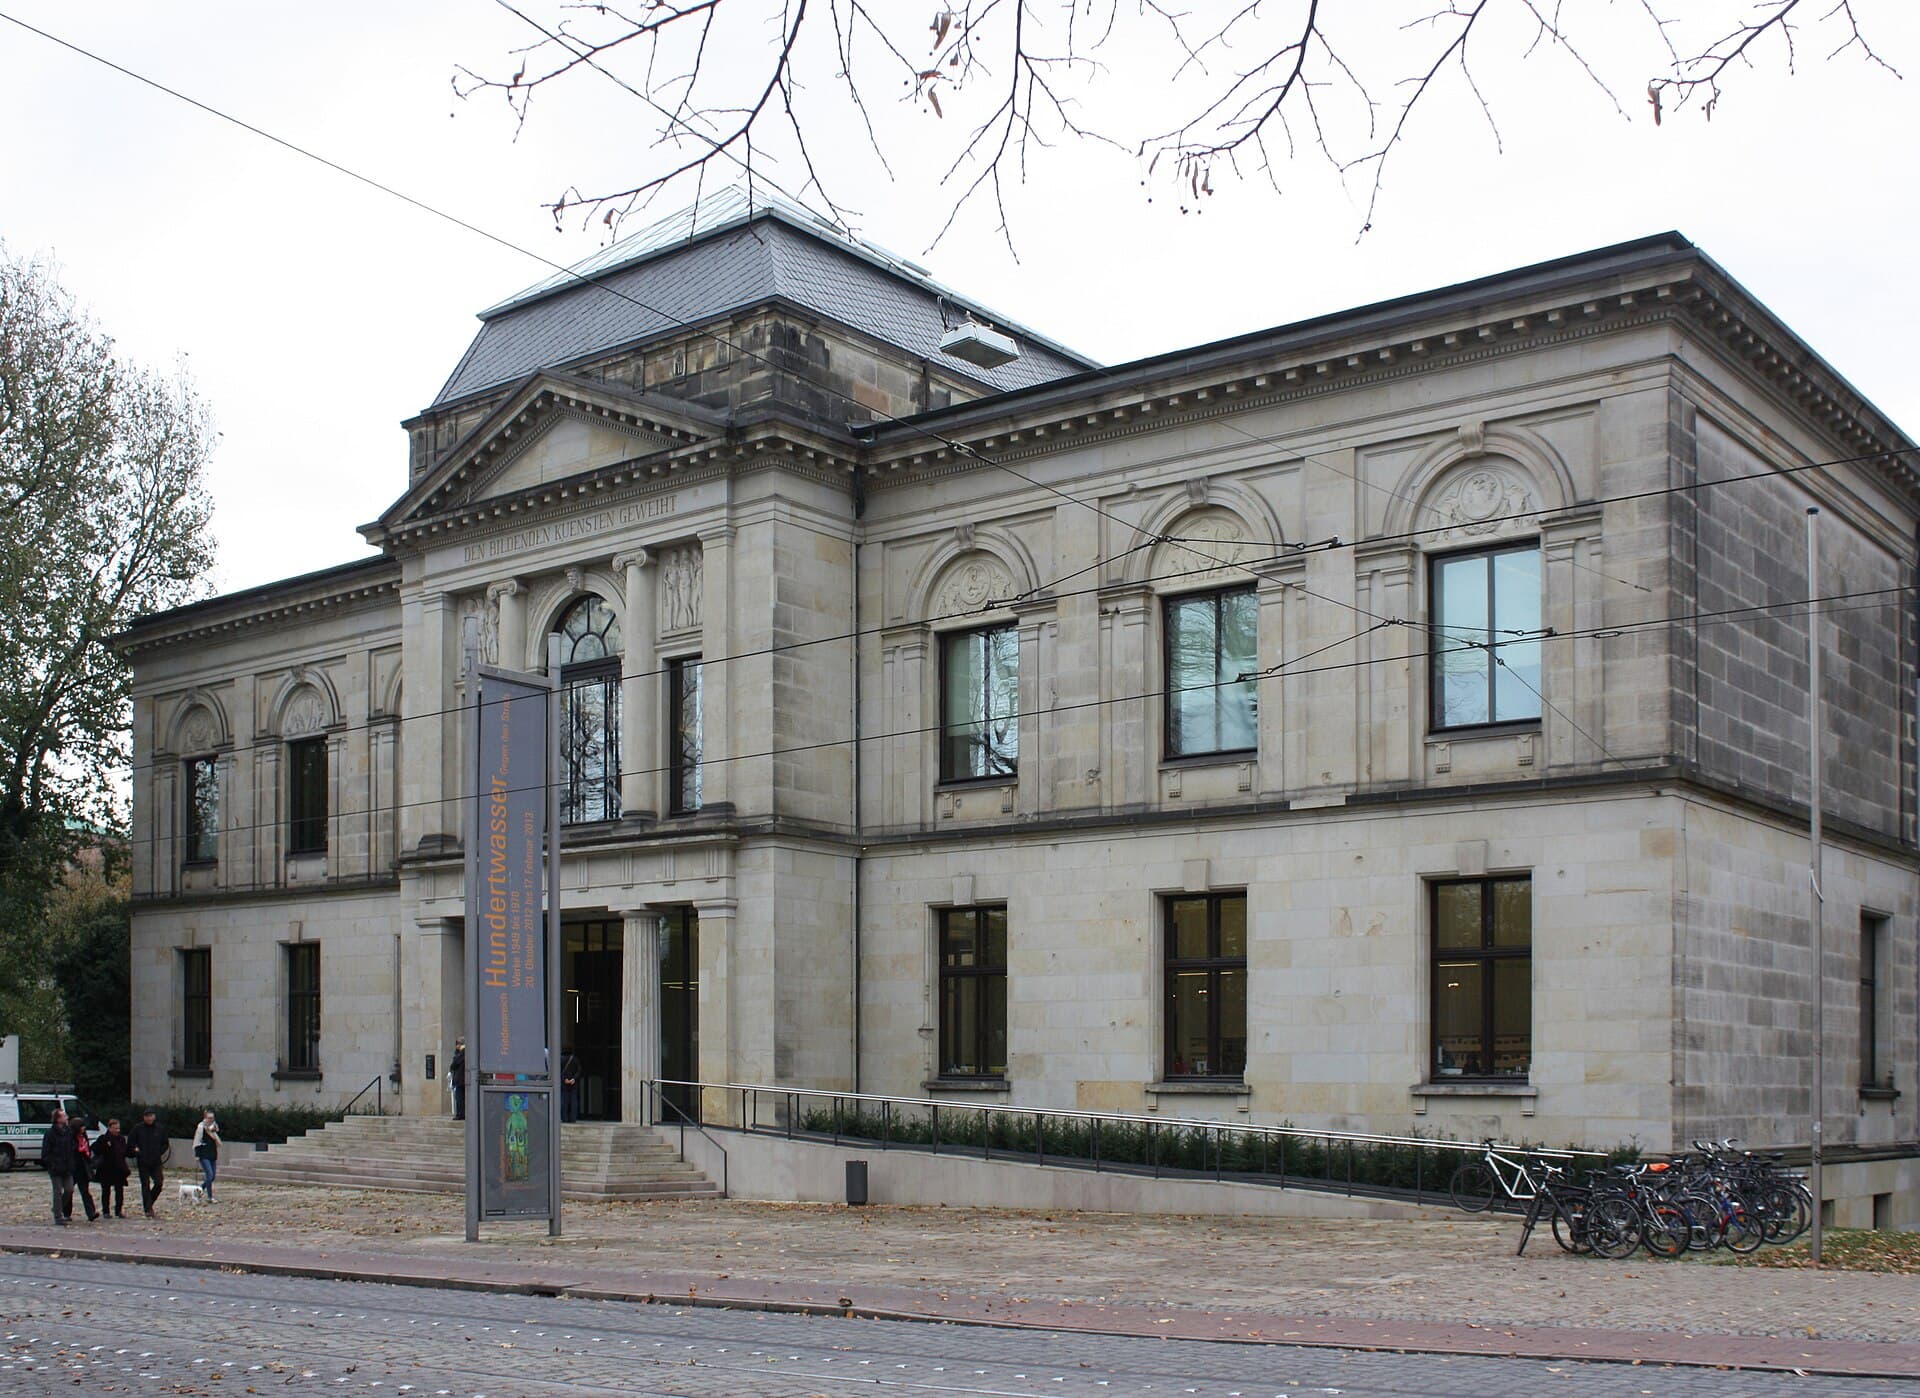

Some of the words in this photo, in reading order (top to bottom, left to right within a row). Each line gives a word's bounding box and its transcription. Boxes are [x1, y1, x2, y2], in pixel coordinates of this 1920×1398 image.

[464, 543, 485, 563] DEN
[489, 530, 551, 557] BILDENDEN
[554, 510, 615, 542] KUENSTEN
[619, 494, 678, 524] GEWEIHT
[484, 775, 508, 987] Hundertwasser
[524, 890, 534, 905] bis
[511, 916, 521, 930] bis
[524, 909, 534, 931] 2012
[511, 932, 521, 955] 1949
[524, 934, 534, 970] Oktober
